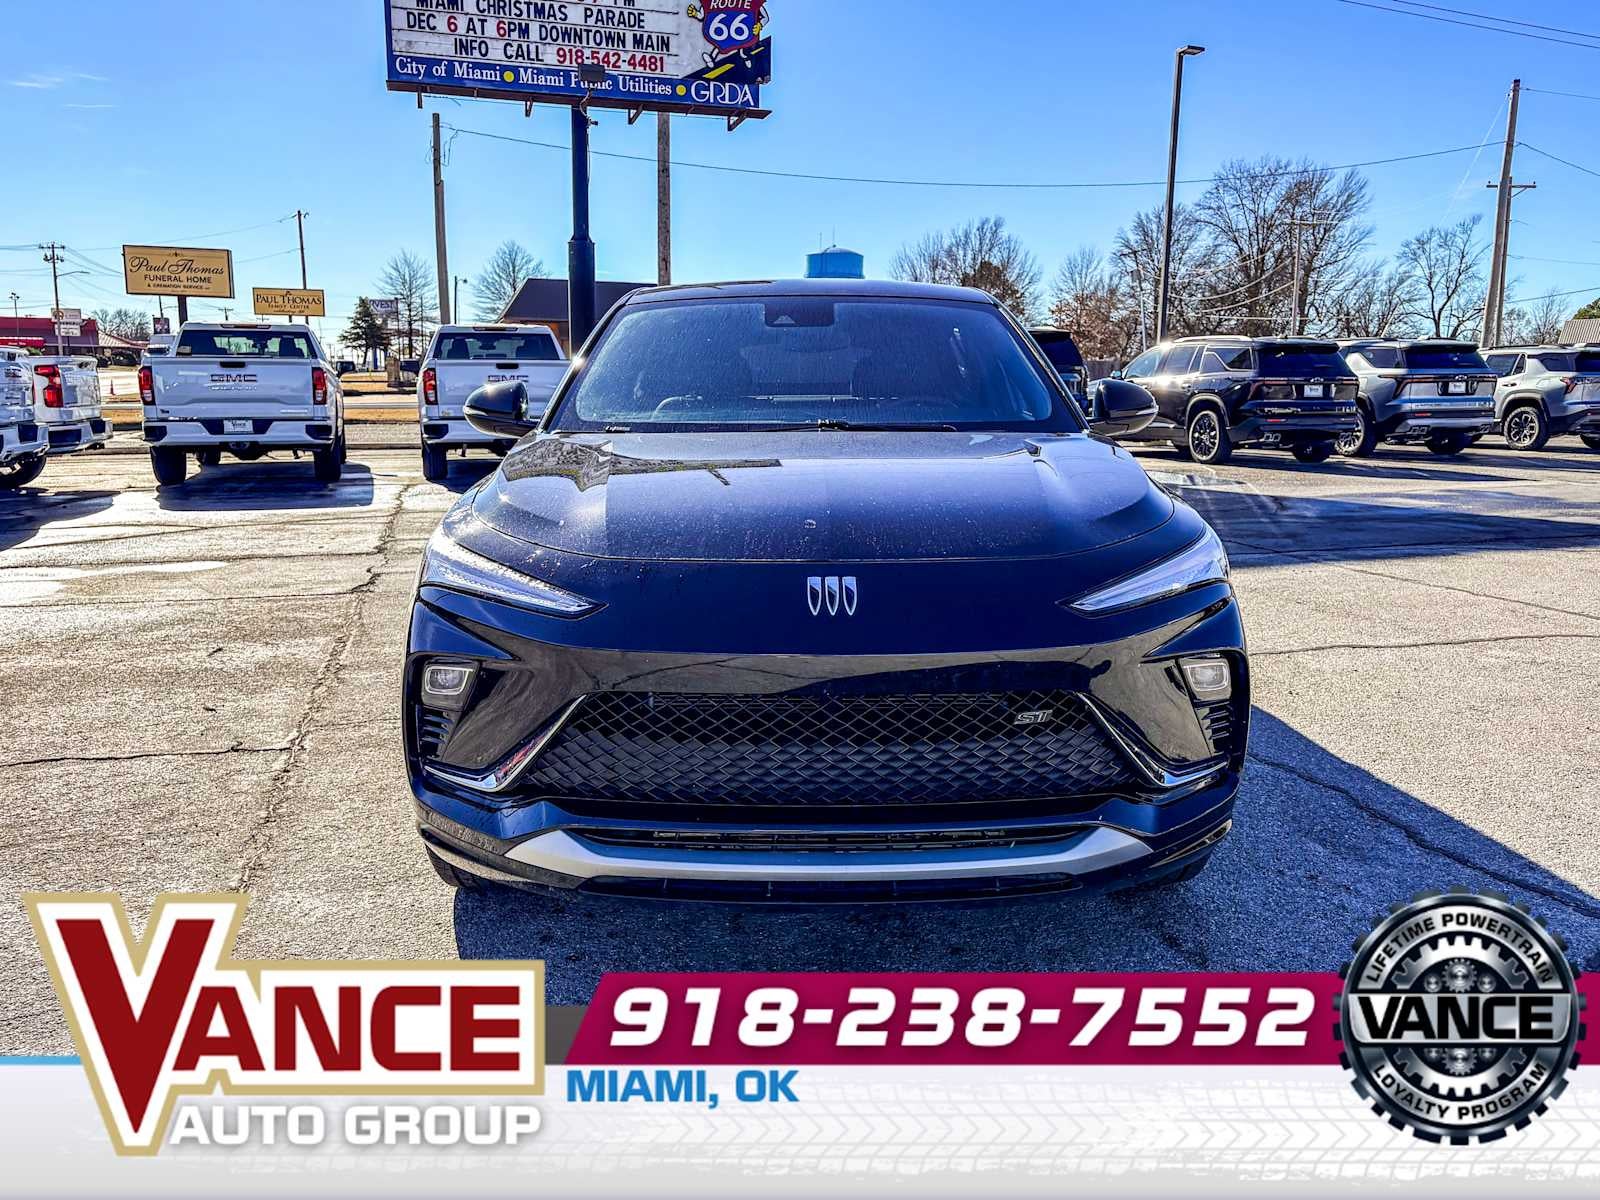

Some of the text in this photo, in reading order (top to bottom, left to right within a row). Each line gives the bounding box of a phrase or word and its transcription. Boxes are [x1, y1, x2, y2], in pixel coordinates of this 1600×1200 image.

[416, 0, 645, 29] MIAMI CHRISTMAS PARADE
[710, 0, 751, 9] ROUTE
[406, 11, 670, 53] DEC 6 AT 6PM DOWNTOWN MAIN
[708, 12, 750, 41] 66
[454, 37, 664, 73] INFO CALL 918-542-4481
[395, 56, 501, 81] City of Miami
[518, 67, 564, 87] Miami
[617, 75, 672, 96] Utilities
[691, 80, 754, 106] GRDA
[129, 256, 225, 275] Paul Thomas
[144, 274, 212, 284] FUNERAL HOME
[256, 293, 322, 305] PAUL THOMAS
[210, 374, 257, 382] GMC
[488, 375, 529, 383] GMC
